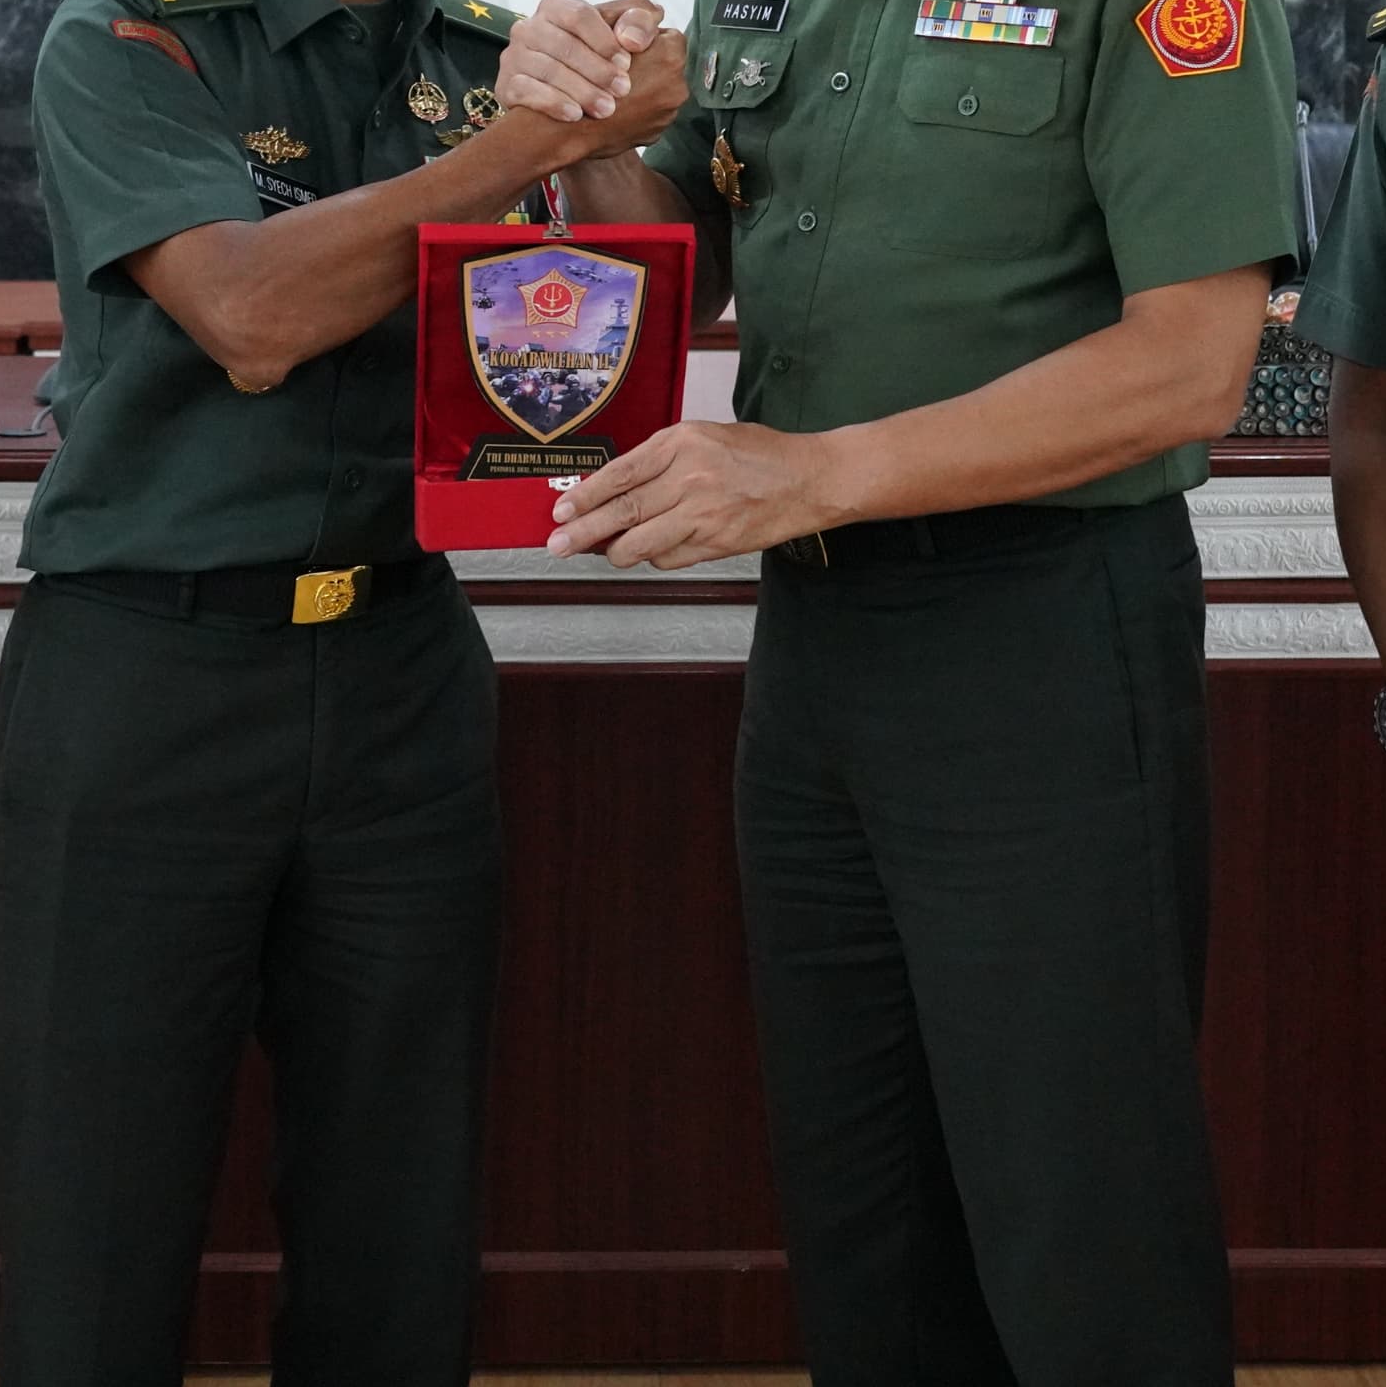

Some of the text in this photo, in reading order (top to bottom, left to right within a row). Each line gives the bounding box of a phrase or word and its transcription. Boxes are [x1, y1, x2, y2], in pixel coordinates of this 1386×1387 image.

[723, 3, 773, 21] HASYIM
[266, 176, 294, 198] SYECH
[503, 453, 542, 465] DHARMA
[576, 455, 603, 467] SAKTI
